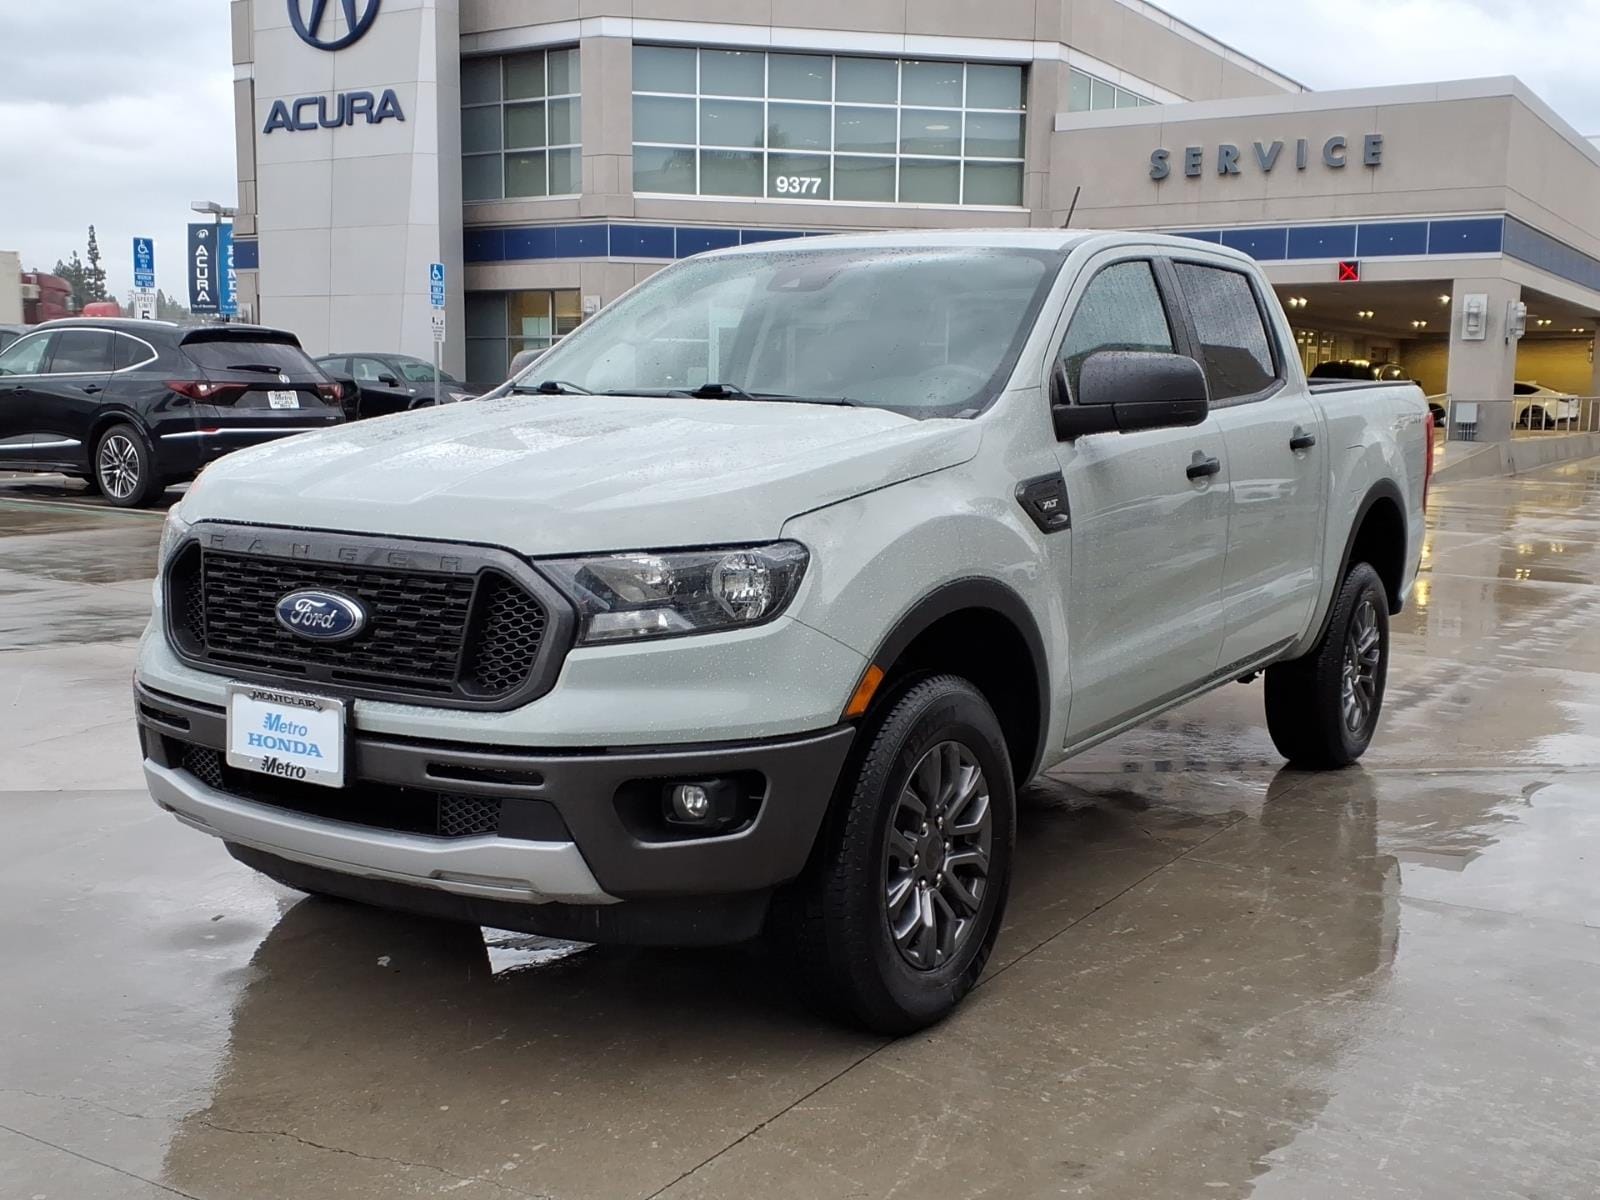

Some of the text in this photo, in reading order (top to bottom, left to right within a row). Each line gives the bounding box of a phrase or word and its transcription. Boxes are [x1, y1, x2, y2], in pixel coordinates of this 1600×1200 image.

[263, 89, 405, 134] ACURA
[1150, 133, 1384, 180] SERVICE
[776, 176, 821, 194] 9377
[195, 244, 211, 302] ACURA
[142, 310, 150, 320] 5
[1042, 498, 1058, 510] XLT
[210, 534, 463, 571] RANGER
[290, 598, 338, 629] Ford
[253, 691, 316, 707] MONTCLAIR
[263, 712, 308, 737] Metro
[248, 732, 323, 758] HONDA
[261, 755, 306, 779] Metro
